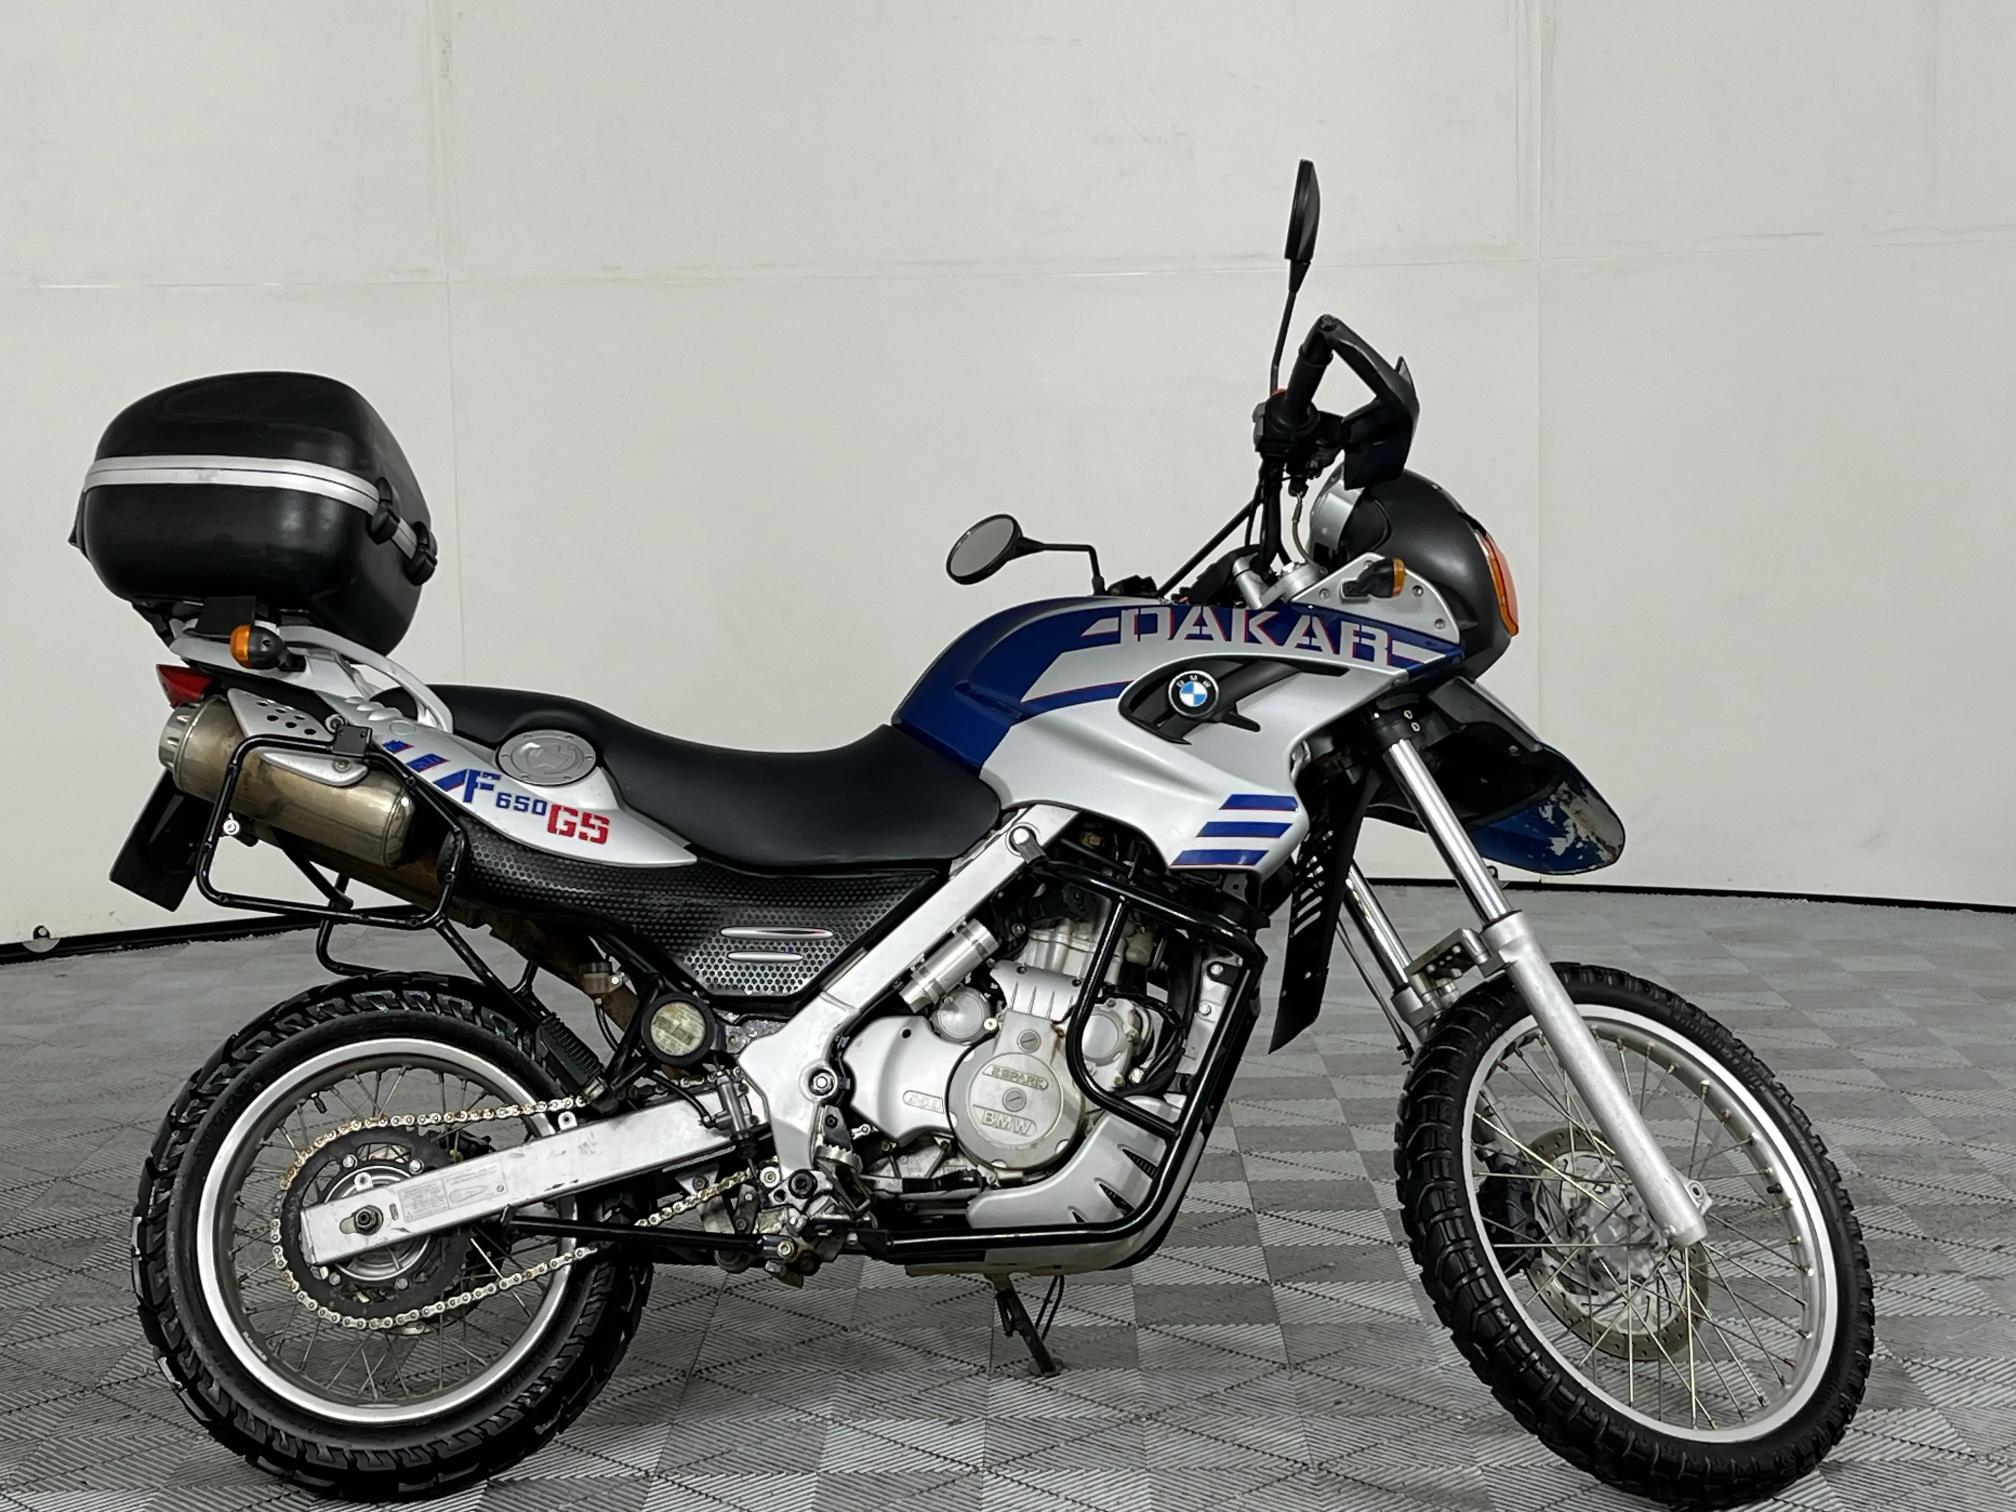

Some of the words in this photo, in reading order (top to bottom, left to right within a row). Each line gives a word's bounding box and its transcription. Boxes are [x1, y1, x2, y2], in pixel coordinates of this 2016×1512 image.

[1120, 605, 1392, 667] DAKAR
[463, 769, 501, 803] F
[496, 792, 548, 816] 650
[547, 804, 610, 844] GS
[982, 1111, 1033, 1136] BMW
